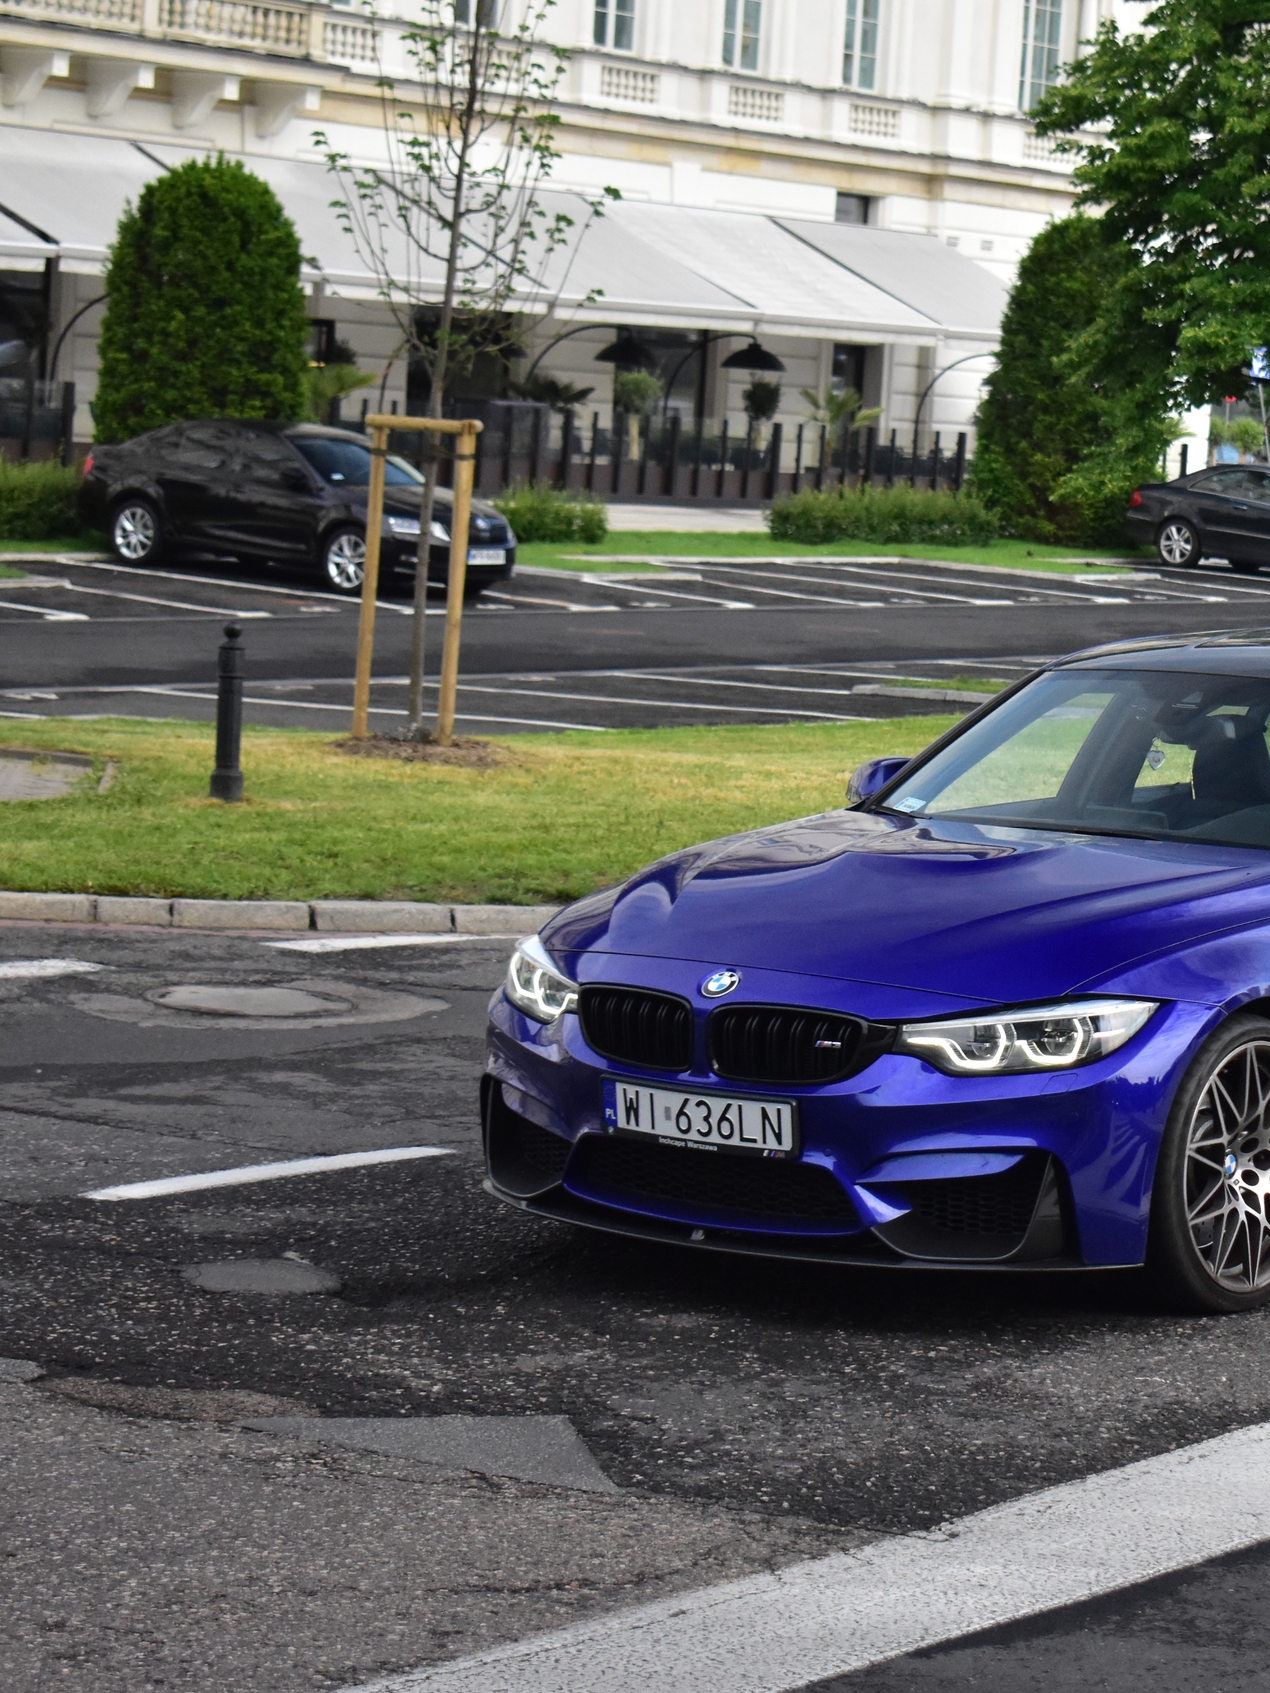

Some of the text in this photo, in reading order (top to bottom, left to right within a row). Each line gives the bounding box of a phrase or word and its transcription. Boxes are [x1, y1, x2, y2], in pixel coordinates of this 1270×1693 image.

[605, 1107, 617, 1120] PL
[622, 1086, 784, 1147] WI 636LN
[658, 1136, 718, 1152] Inchcape Warszawa
